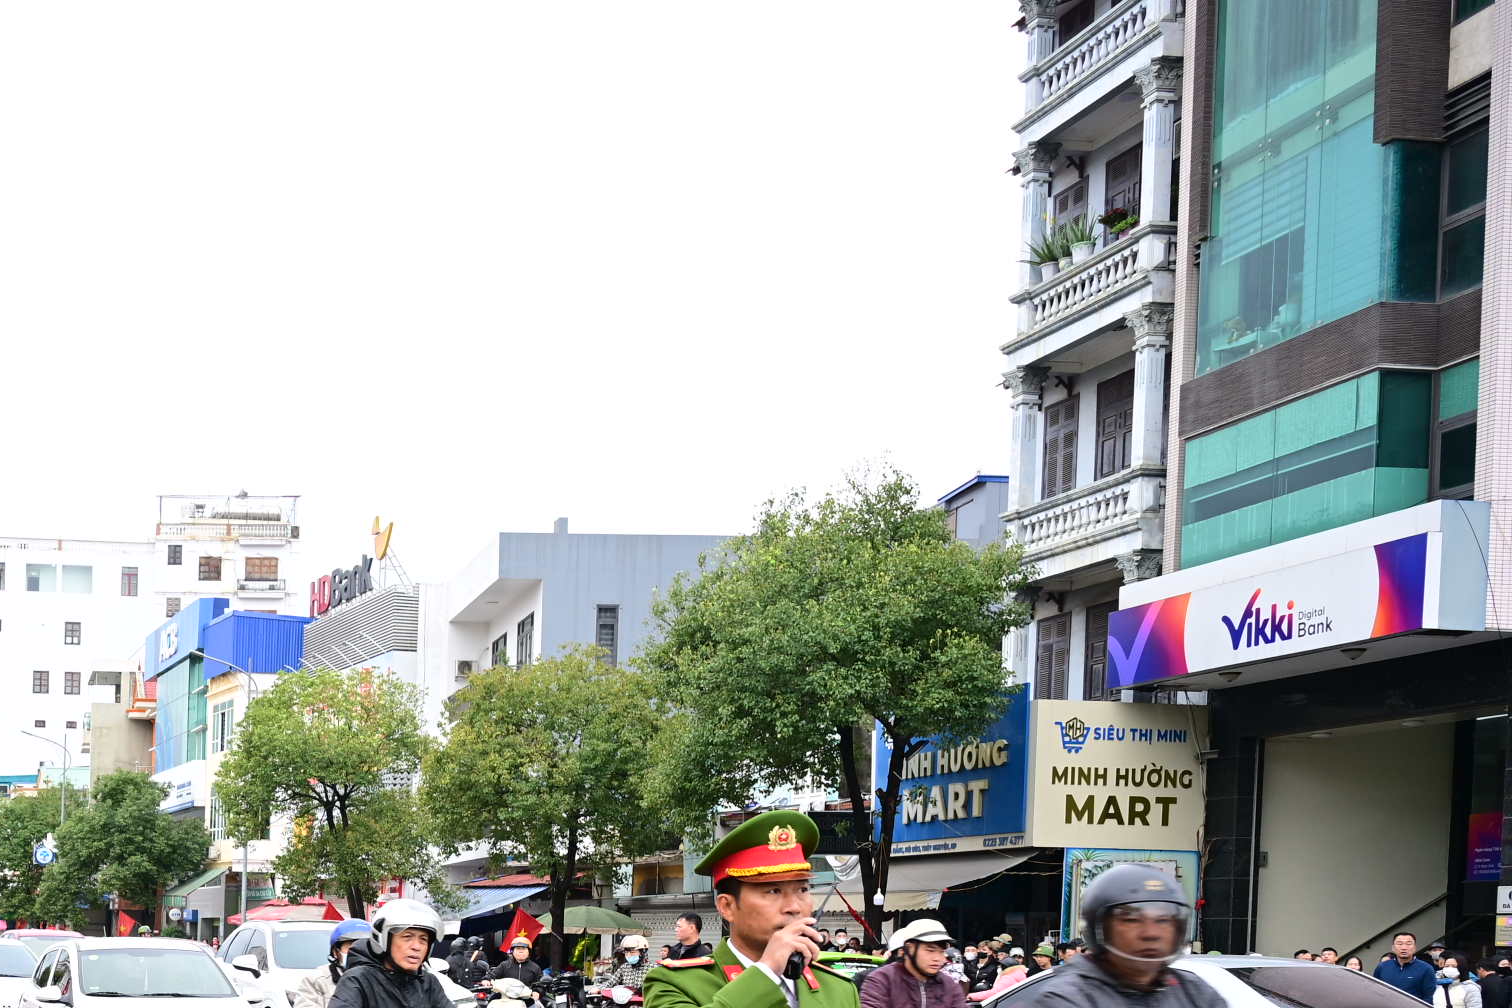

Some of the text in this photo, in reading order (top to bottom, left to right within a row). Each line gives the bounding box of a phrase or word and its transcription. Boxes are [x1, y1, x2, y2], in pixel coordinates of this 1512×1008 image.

[310, 554, 374, 618] HDBank
[1221, 587, 1295, 651] Vikki
[1297, 617, 1333, 639] Bank
[1298, 606, 1326, 622] Digital
[1093, 724, 1187, 744] SIÊU THỊ MINI
[1051, 762, 1193, 789] MINH HƯỜNG
[902, 778, 988, 825] MART
[1064, 794, 1178, 827] MART
